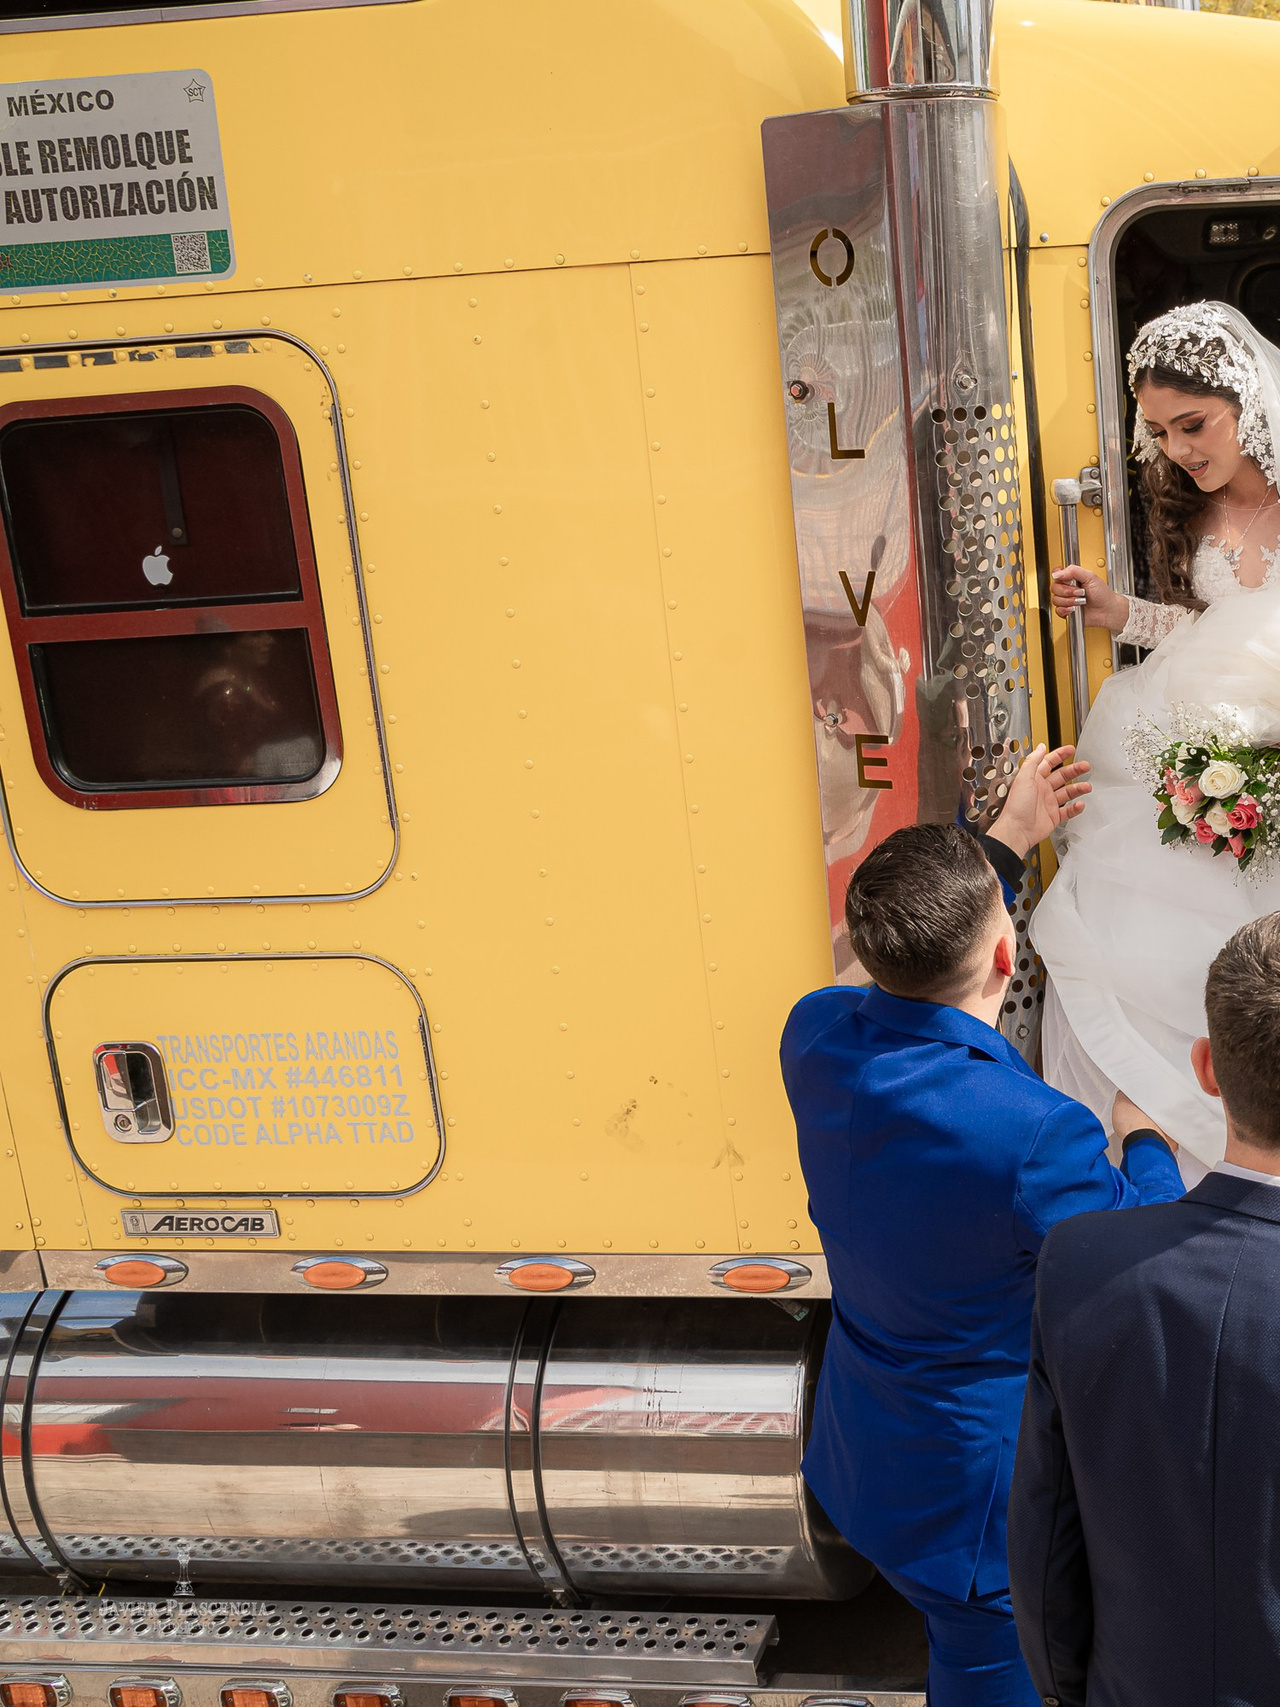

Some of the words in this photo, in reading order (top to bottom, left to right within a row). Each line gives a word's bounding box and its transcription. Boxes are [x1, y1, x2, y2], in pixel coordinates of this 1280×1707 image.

[7, 89, 115, 118] MÉXICO
[188, 87, 203, 97] SCT
[0, 140, 34, 177] LE
[37, 128, 194, 174] REMOLQUE
[4, 171, 218, 225] AUTORIZACIÓN
[157, 1033, 299, 1064] TRANSPORTES
[305, 1030, 399, 1061] ARANDAS
[168, 1067, 277, 1091] ICC-MX
[285, 1064, 402, 1088] #446811
[171, 1096, 261, 1120] USDOT
[271, 1094, 411, 1118] #1073009Z
[176, 1123, 248, 1146] CODE
[255, 1121, 343, 1146] ALPHA
[347, 1120, 414, 1144] TTAD
